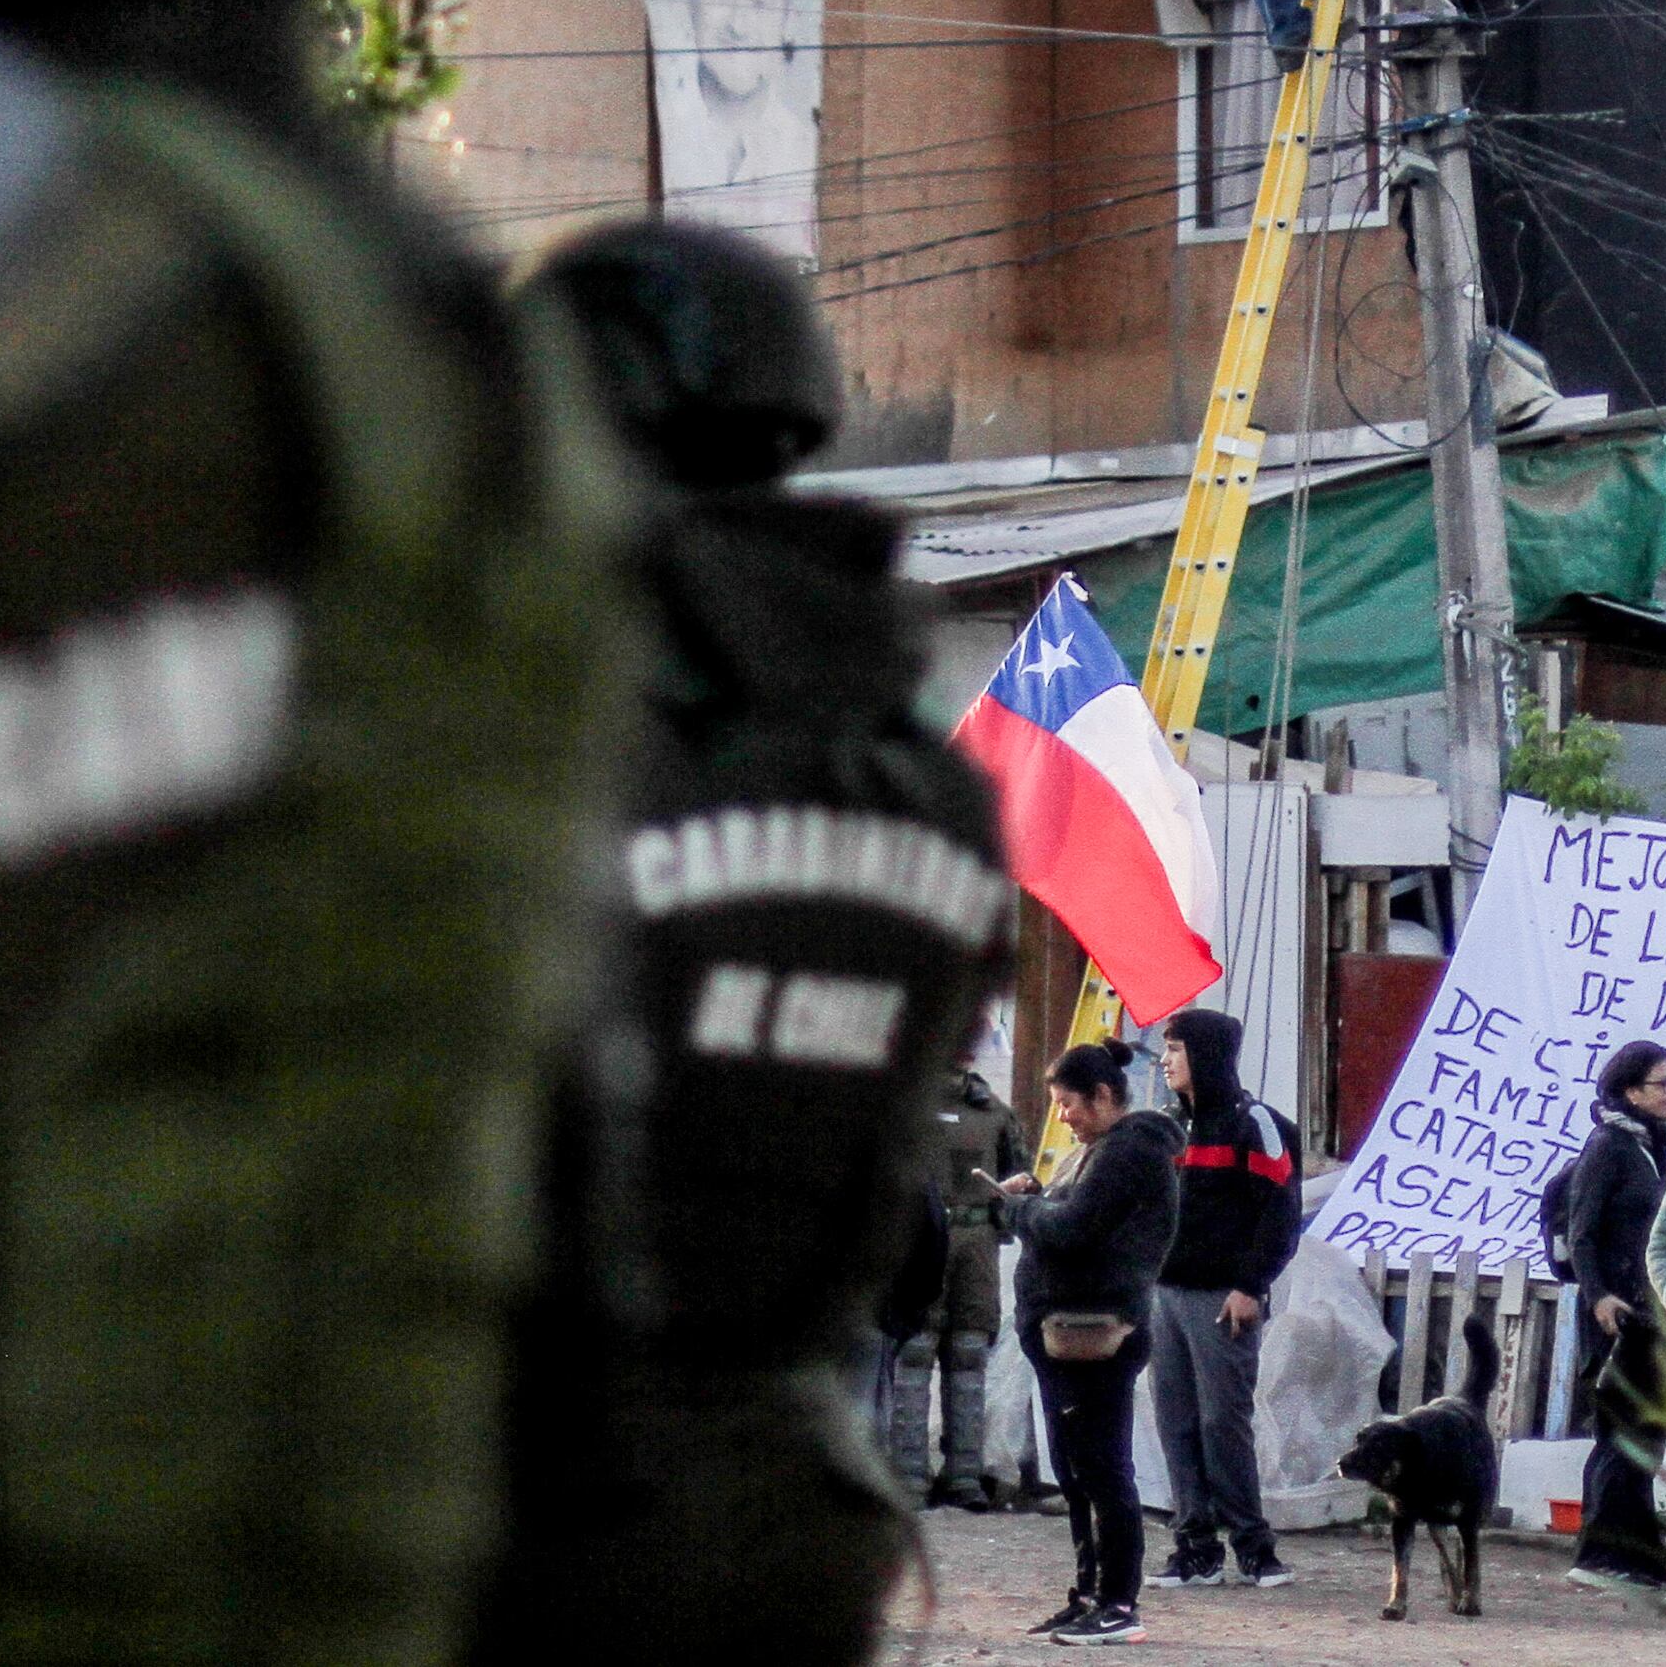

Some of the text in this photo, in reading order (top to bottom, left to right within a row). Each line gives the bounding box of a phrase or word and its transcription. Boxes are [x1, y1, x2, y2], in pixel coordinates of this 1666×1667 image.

[1565, 902, 1620, 957] DE
[1434, 987, 1523, 1054] DE
[1572, 971, 1635, 1024] DE
[1429, 1051, 1581, 1141] FAMIL
[1389, 1100, 1582, 1186] CATAST
